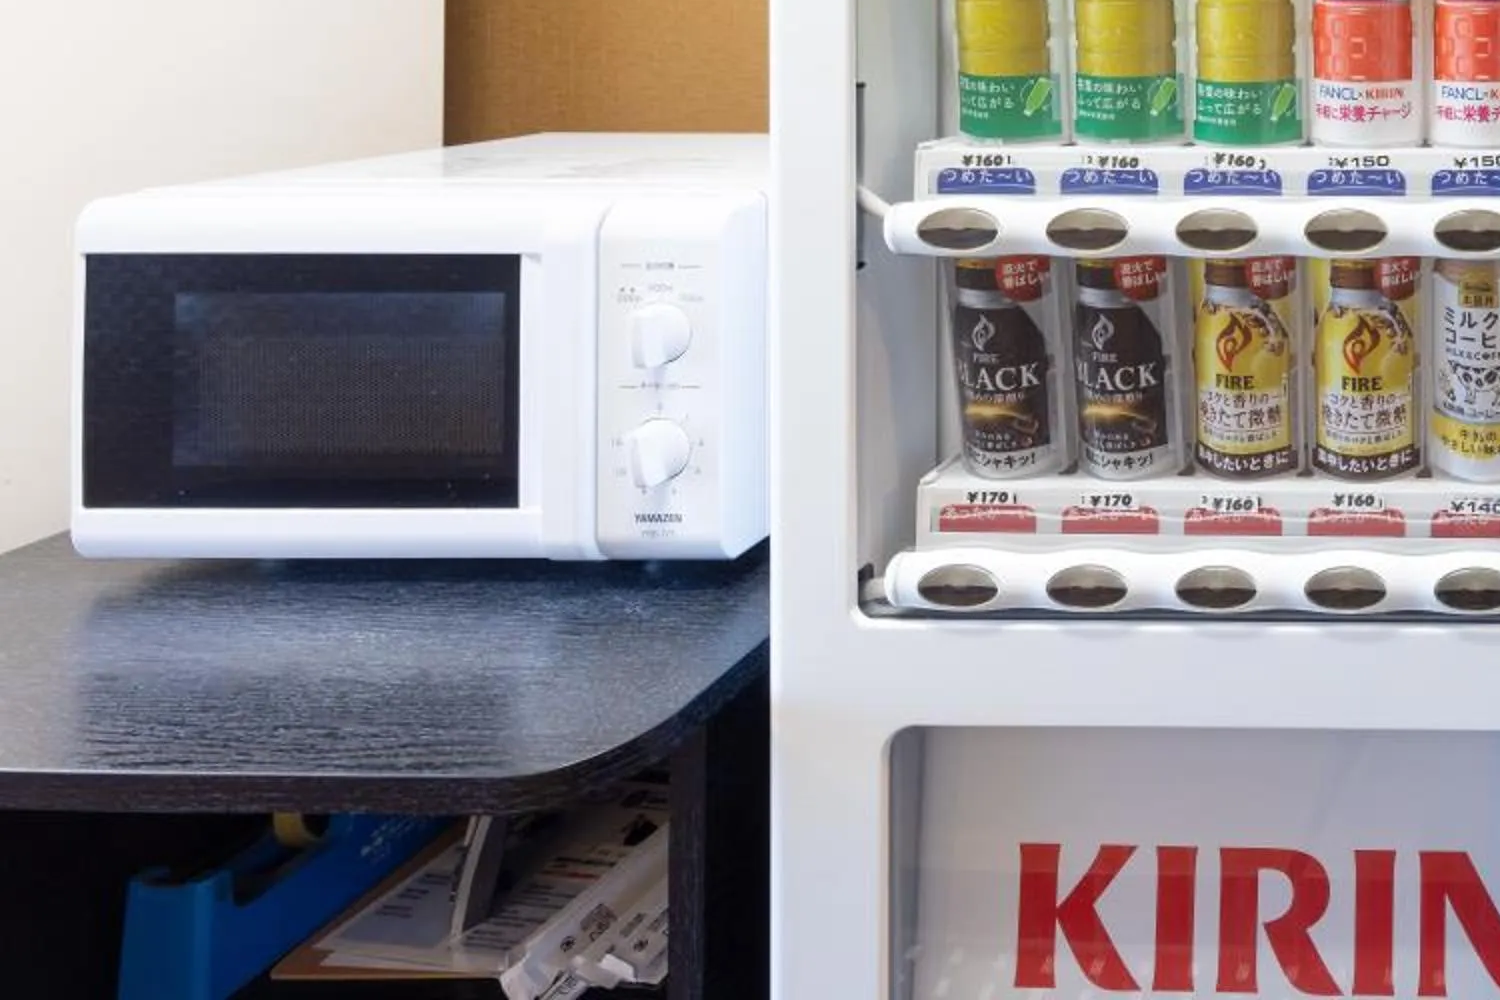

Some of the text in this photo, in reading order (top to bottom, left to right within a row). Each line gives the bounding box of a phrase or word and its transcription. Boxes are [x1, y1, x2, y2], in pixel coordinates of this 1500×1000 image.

[963, 154, 1002, 167] ¥160
[1099, 156, 1139, 169] ¥160
[1215, 153, 1254, 168] ¥160
[1335, 155, 1390, 168] ¥150
[1215, 373, 1255, 391] FIRE
[1341, 376, 1383, 393] FIRE
[967, 491, 1008, 504] ¥170
[1090, 494, 1132, 507] ¥170
[1212, 497, 1253, 511] ¥160
[1333, 493, 1375, 507] ¥160
[634, 513, 683, 523] YAMAZEN
